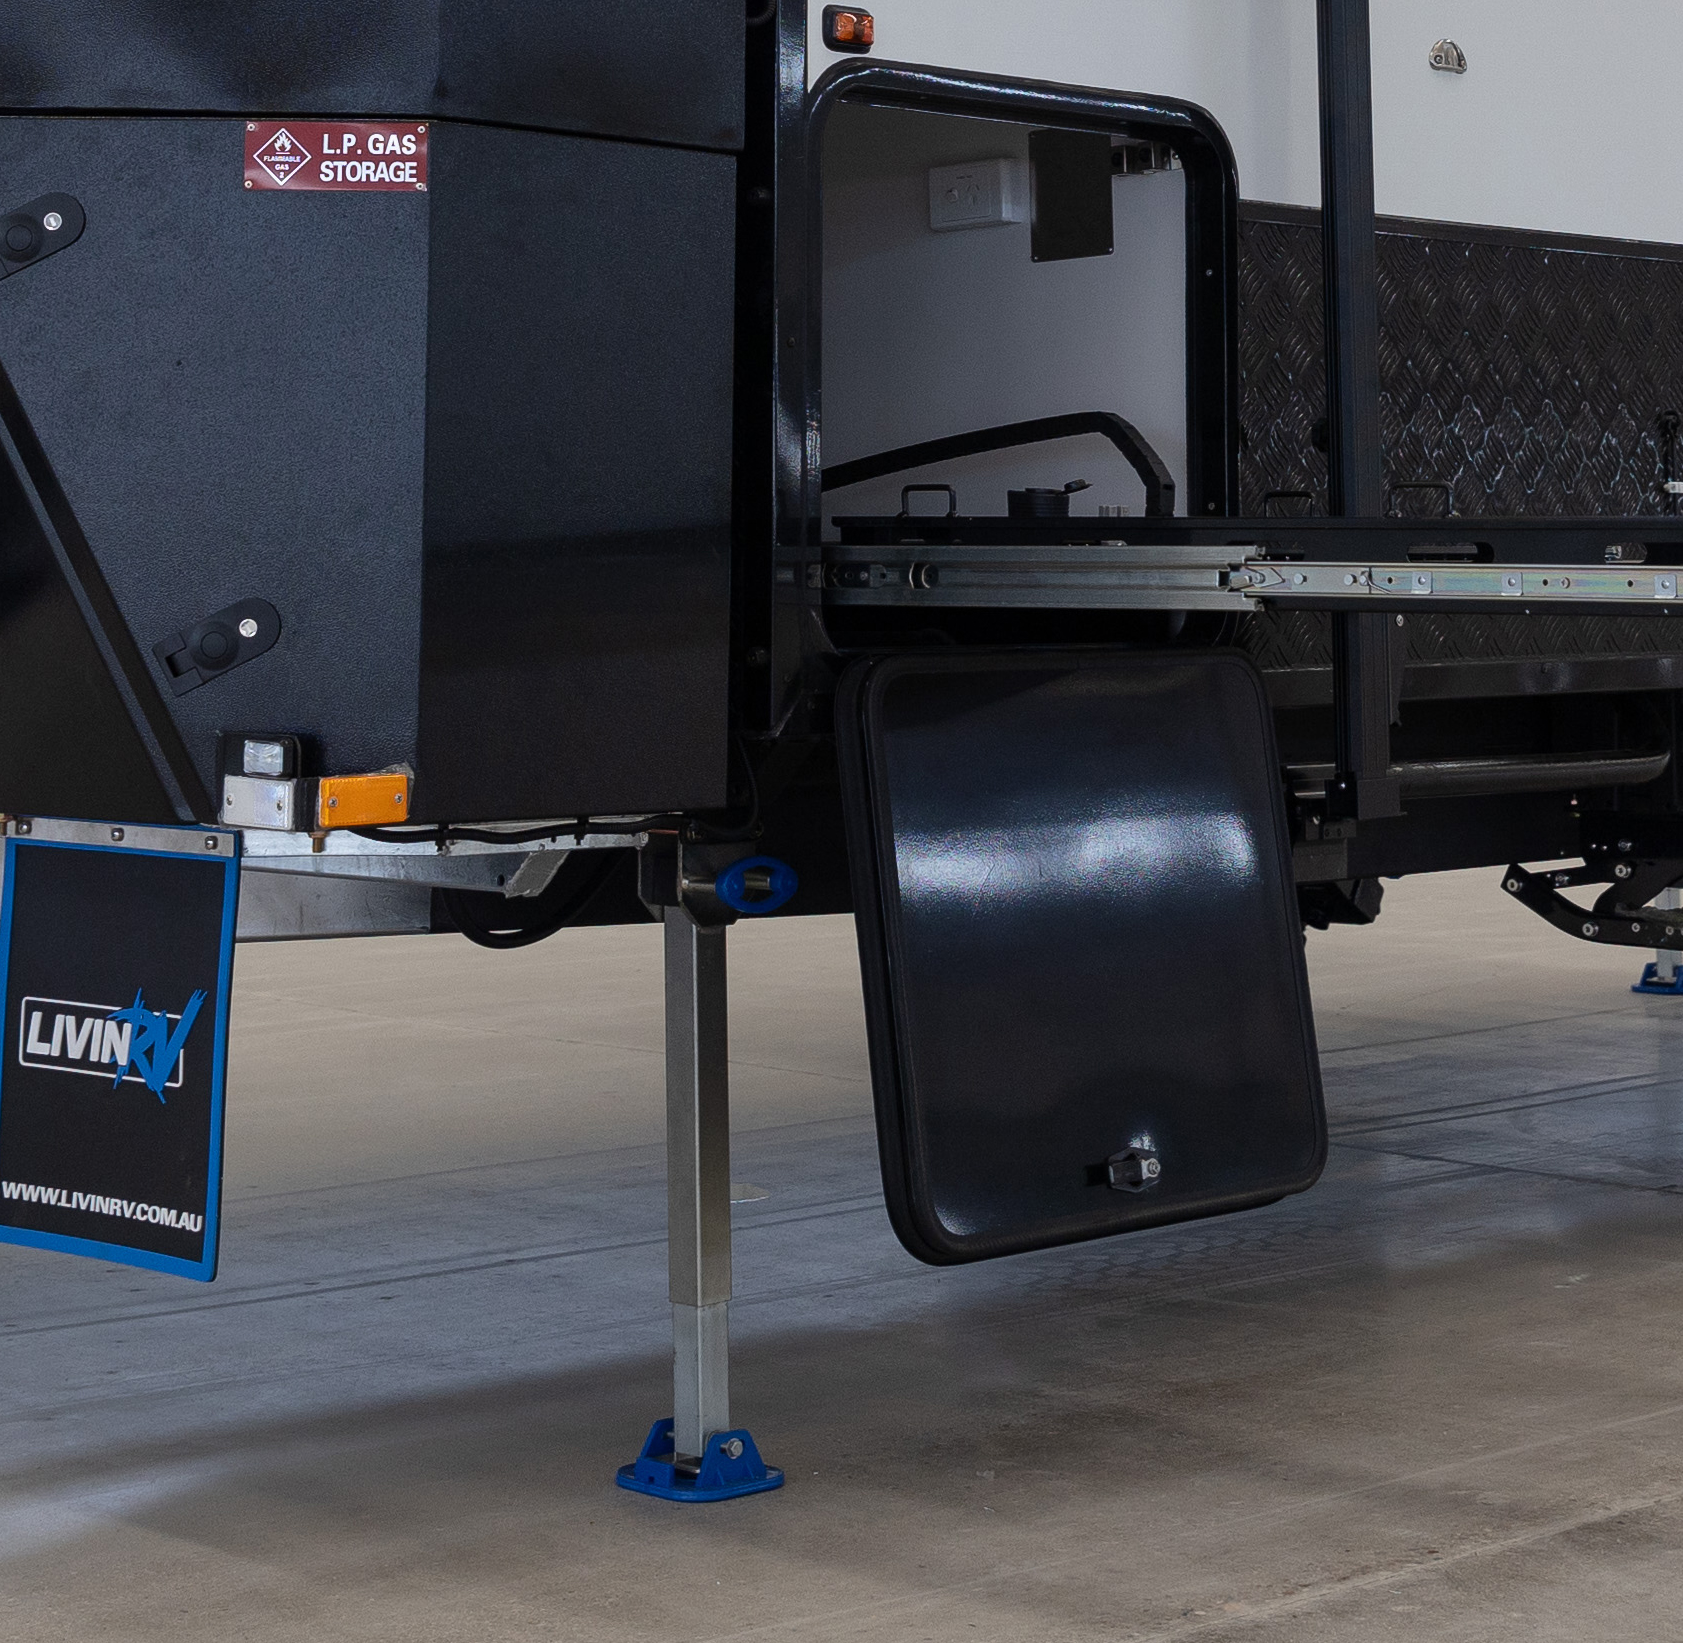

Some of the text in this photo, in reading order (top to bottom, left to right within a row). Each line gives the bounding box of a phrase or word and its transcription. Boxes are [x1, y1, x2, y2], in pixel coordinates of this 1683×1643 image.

[322, 133, 417, 155] L.P. GAS
[274, 163, 290, 171] GAS
[278, 171, 285, 179] 2
[319, 161, 418, 183] STORAGE
[1, 1180, 204, 1233] WWW.LIVINRV.COM.AU
